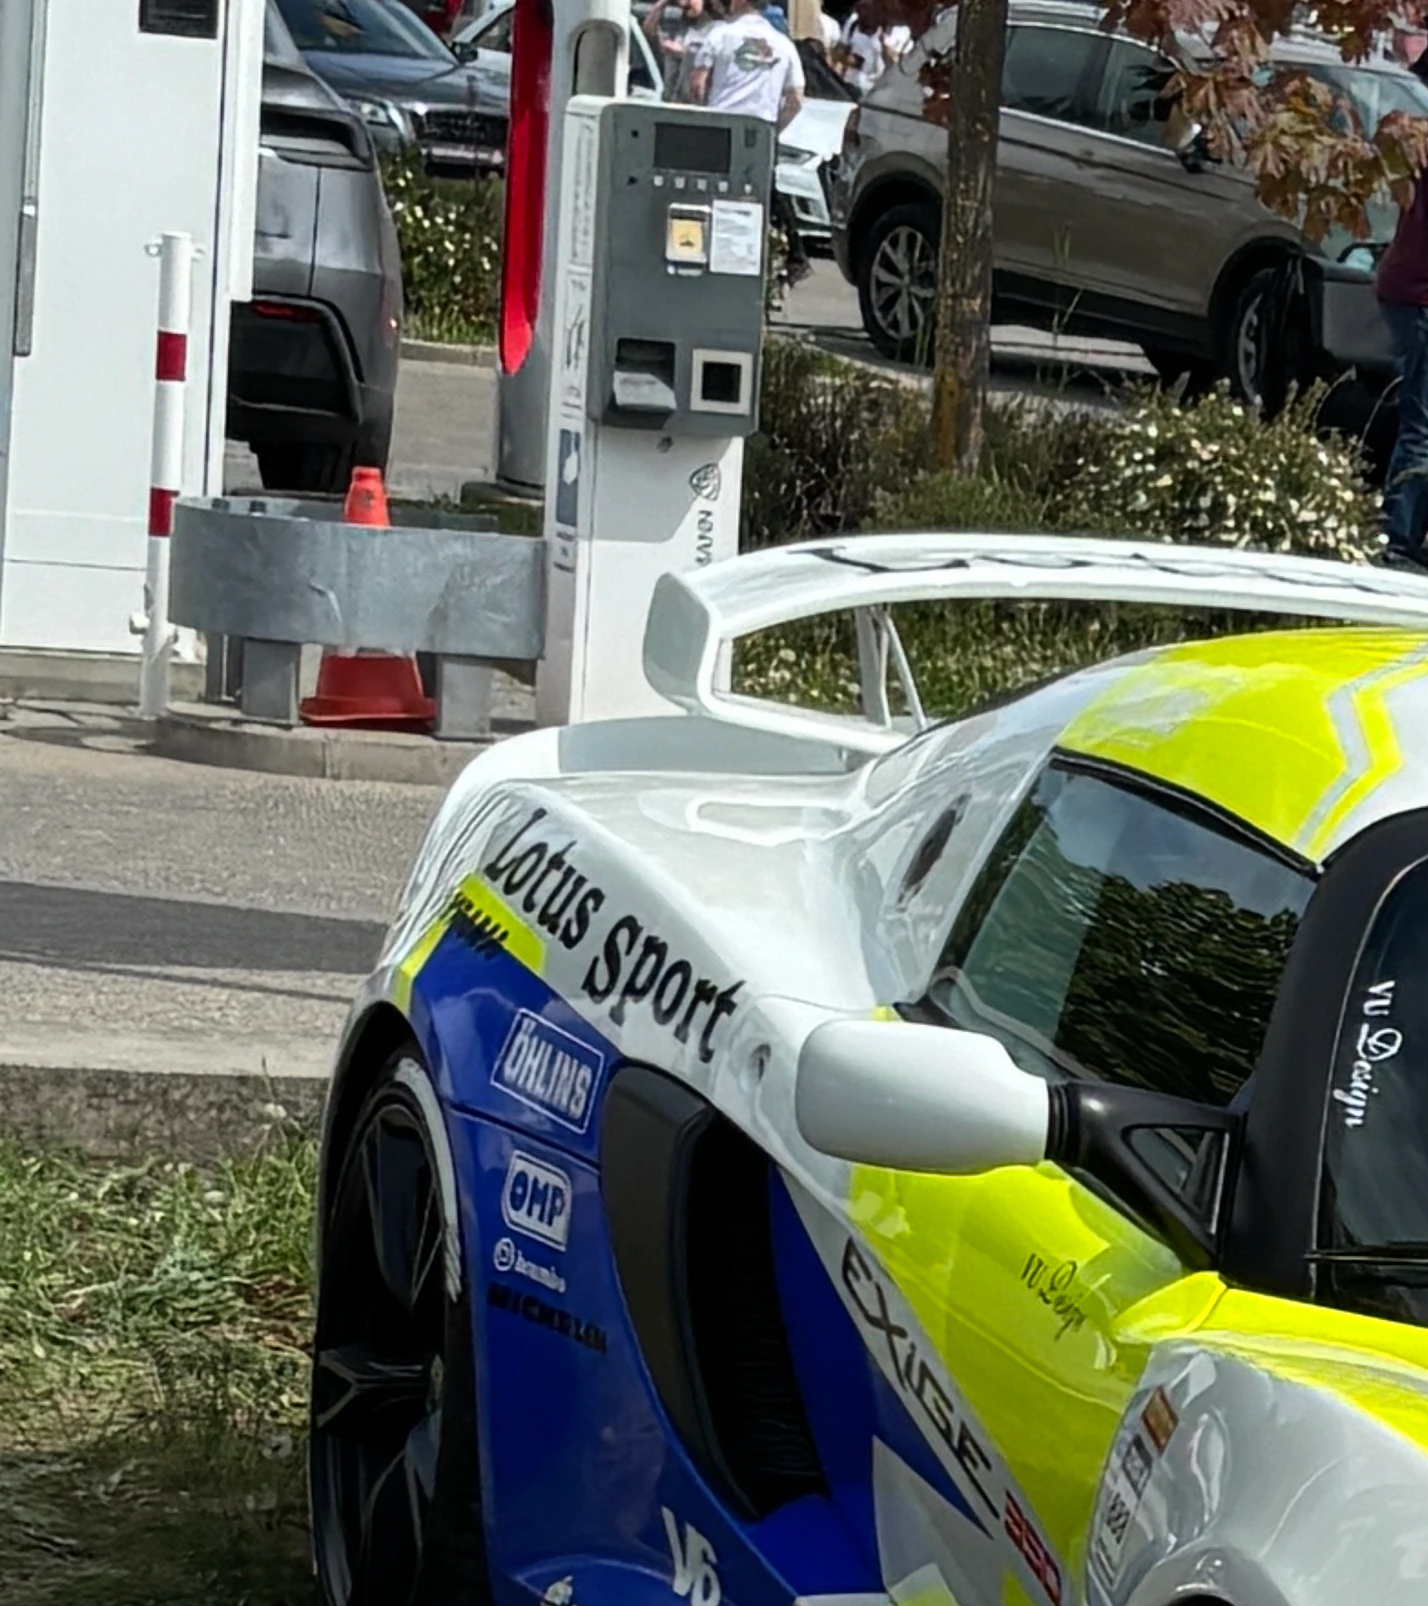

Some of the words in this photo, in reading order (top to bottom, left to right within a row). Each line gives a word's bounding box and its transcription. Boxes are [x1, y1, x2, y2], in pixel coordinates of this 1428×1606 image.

[484, 807, 607, 950] Lotus
[581, 915, 747, 1064] Sport
[510, 1169, 566, 1230] OMP
[842, 1235, 1000, 1520] EXIGE
